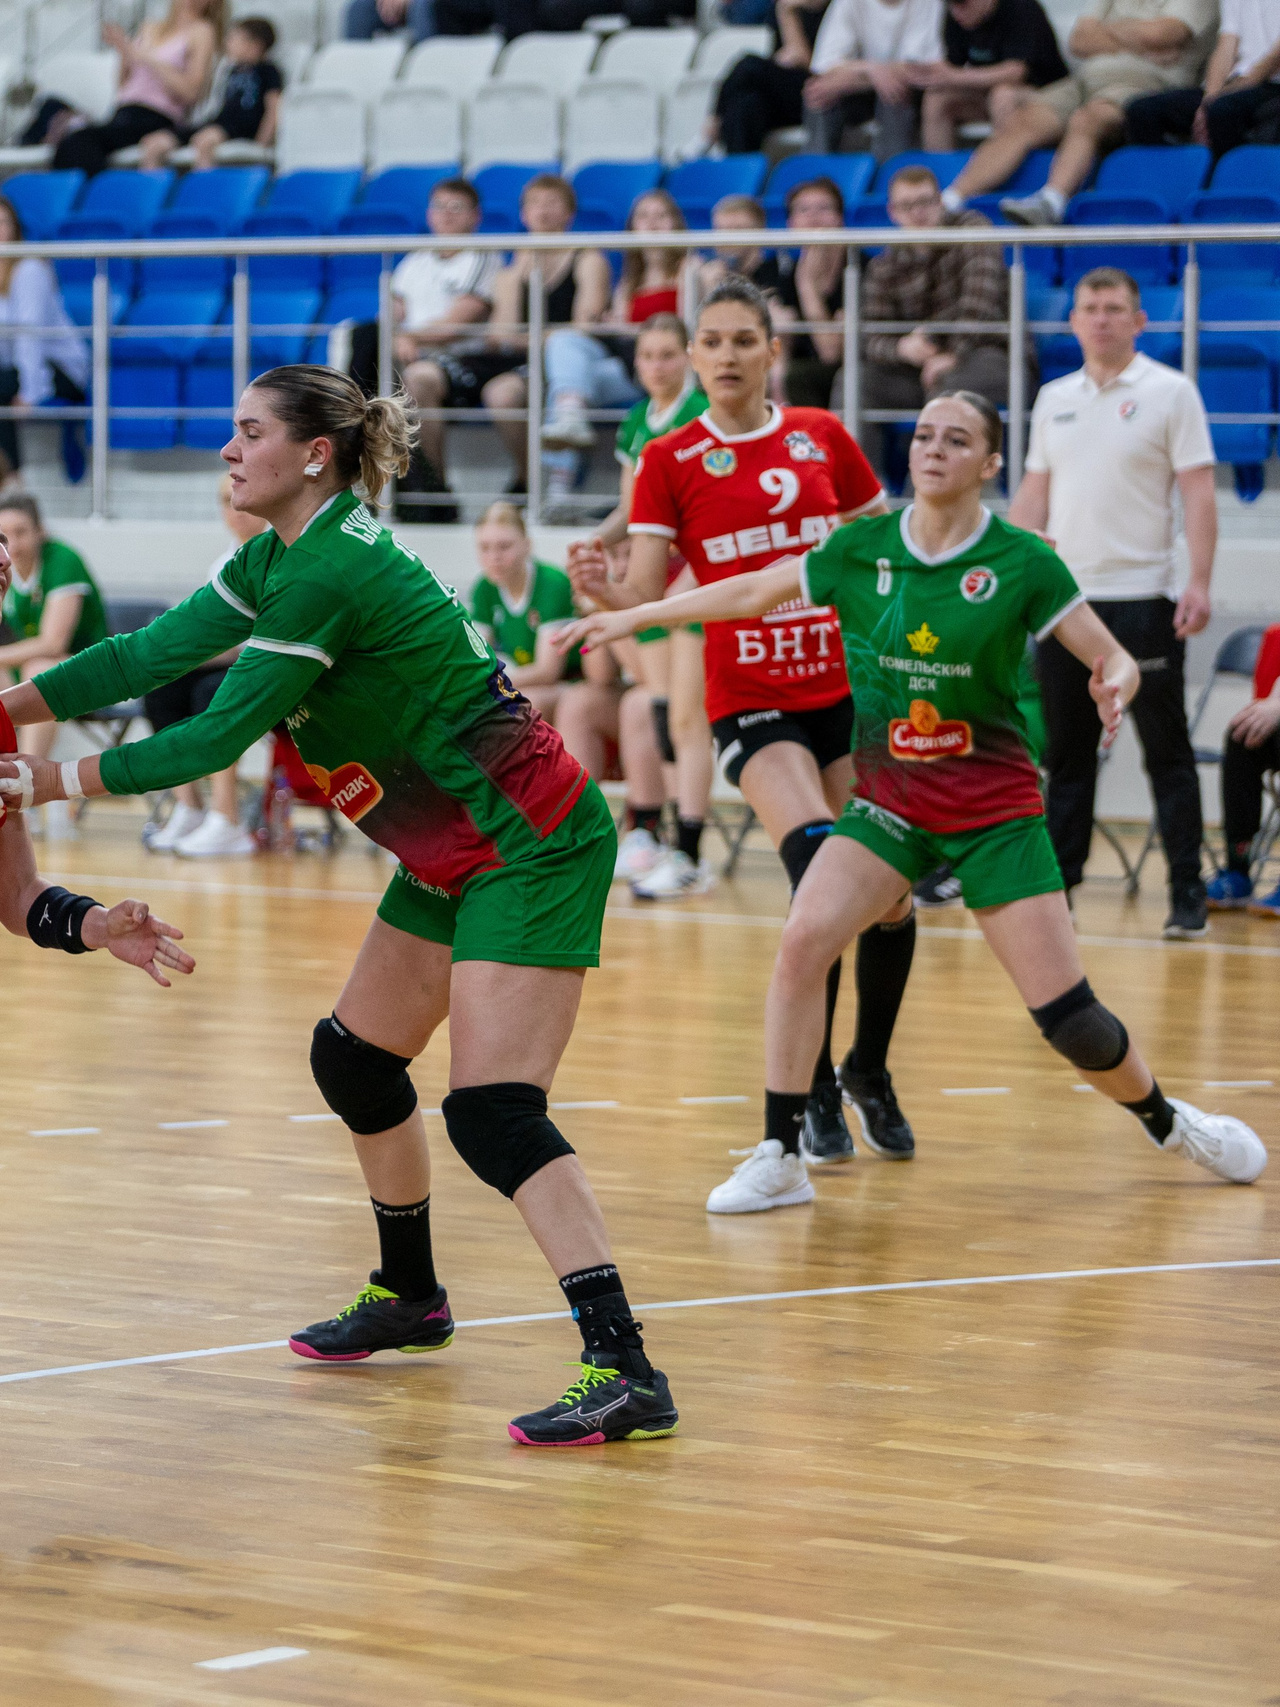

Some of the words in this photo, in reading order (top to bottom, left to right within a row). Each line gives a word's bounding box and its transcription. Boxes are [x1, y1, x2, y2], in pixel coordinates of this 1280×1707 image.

[758, 467, 801, 515] 9
[701, 514, 840, 564] BELA
[876, 557, 893, 596] 6
[735, 619, 841, 665] БНТ
[878, 655, 973, 678] ГОМЕЛЬСКИЙ
[908, 676, 937, 691] ДСК
[738, 709, 782, 729] Kempa
[405, 871, 450, 900] ГОМЕЛЯ
